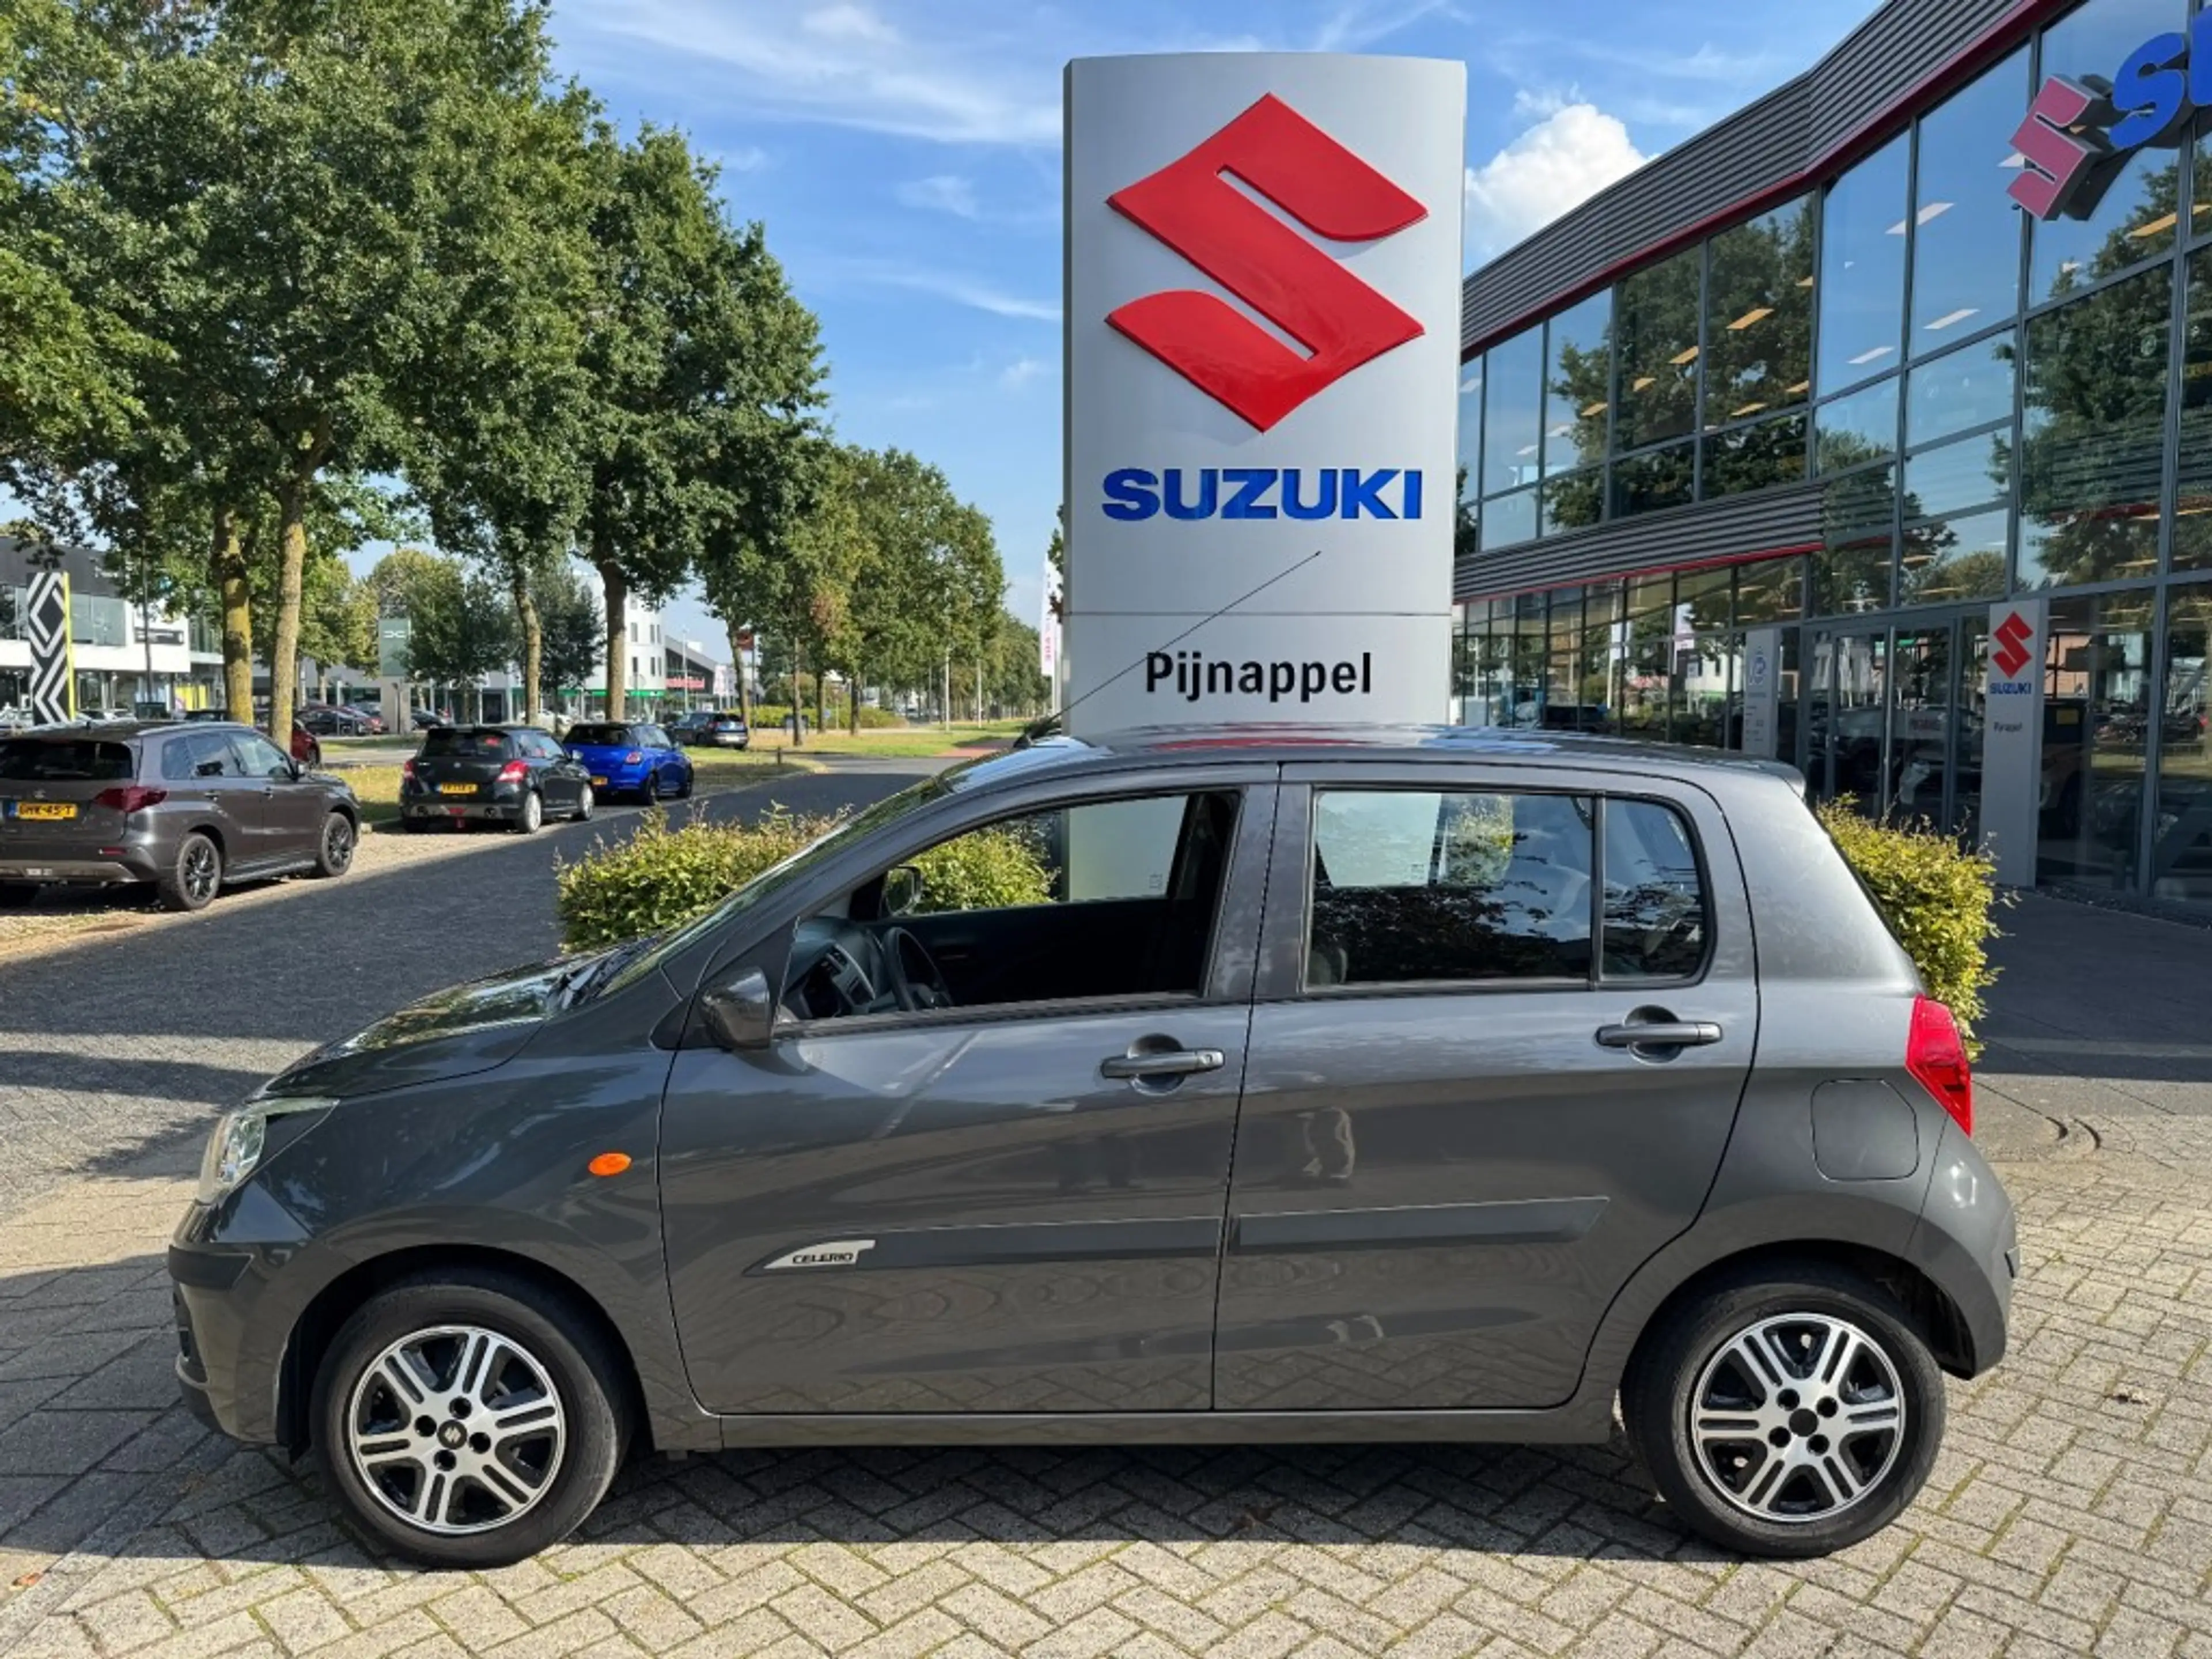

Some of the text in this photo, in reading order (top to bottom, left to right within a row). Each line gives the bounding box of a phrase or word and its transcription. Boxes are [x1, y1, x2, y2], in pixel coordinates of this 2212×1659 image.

[1101, 467, 1423, 521] SUZUKI
[1146, 651, 1372, 702] Pijnappel
[1989, 682, 2032, 695] SUZUKI
[793, 1252, 854, 1264] CELERIO
